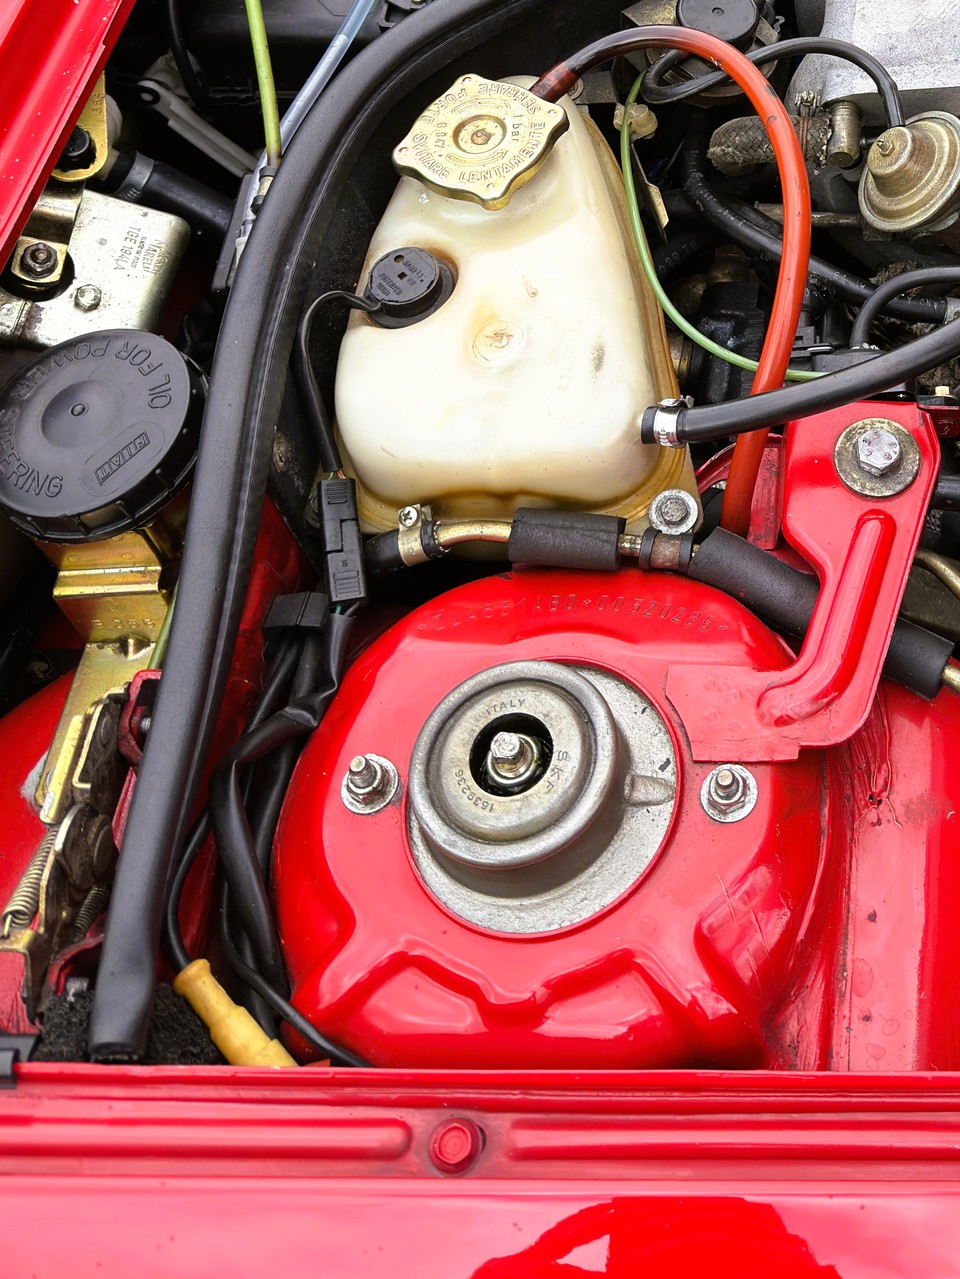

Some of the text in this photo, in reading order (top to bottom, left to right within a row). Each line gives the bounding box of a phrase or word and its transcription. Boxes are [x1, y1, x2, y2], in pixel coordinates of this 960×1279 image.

[419, 83, 541, 124] SERRARE FORTE
[413, 133, 450, 179] SVITARE
[458, 122, 546, 182] LENTAMENTE
[10, 339, 111, 400] POWER
[115, 341, 163, 376] FOR
[148, 373, 172, 409] OIL
[485, 698, 526, 716] ITALY
[454, 770, 496, 813] 1639236
